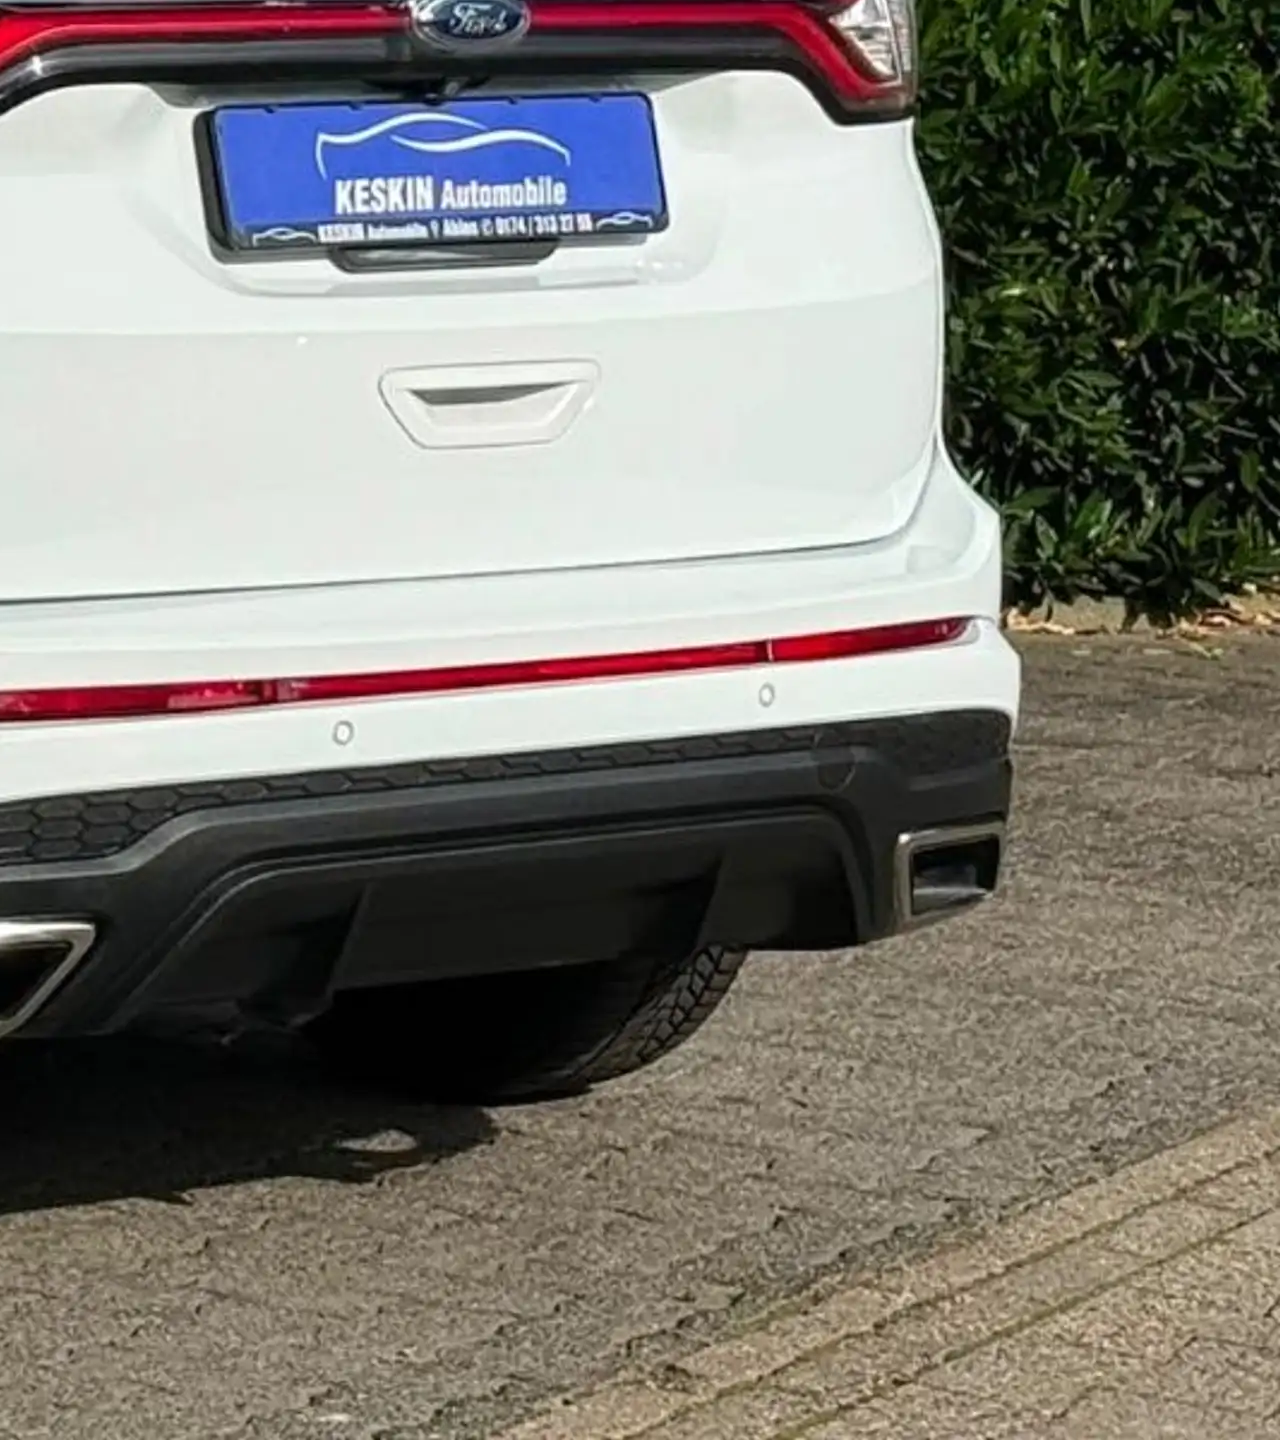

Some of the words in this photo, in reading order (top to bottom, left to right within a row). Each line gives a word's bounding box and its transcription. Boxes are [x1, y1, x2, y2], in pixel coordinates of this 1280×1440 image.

[449, 1, 507, 35] Ford
[335, 175, 434, 214] KESKIN
[440, 176, 567, 209] Automobile
